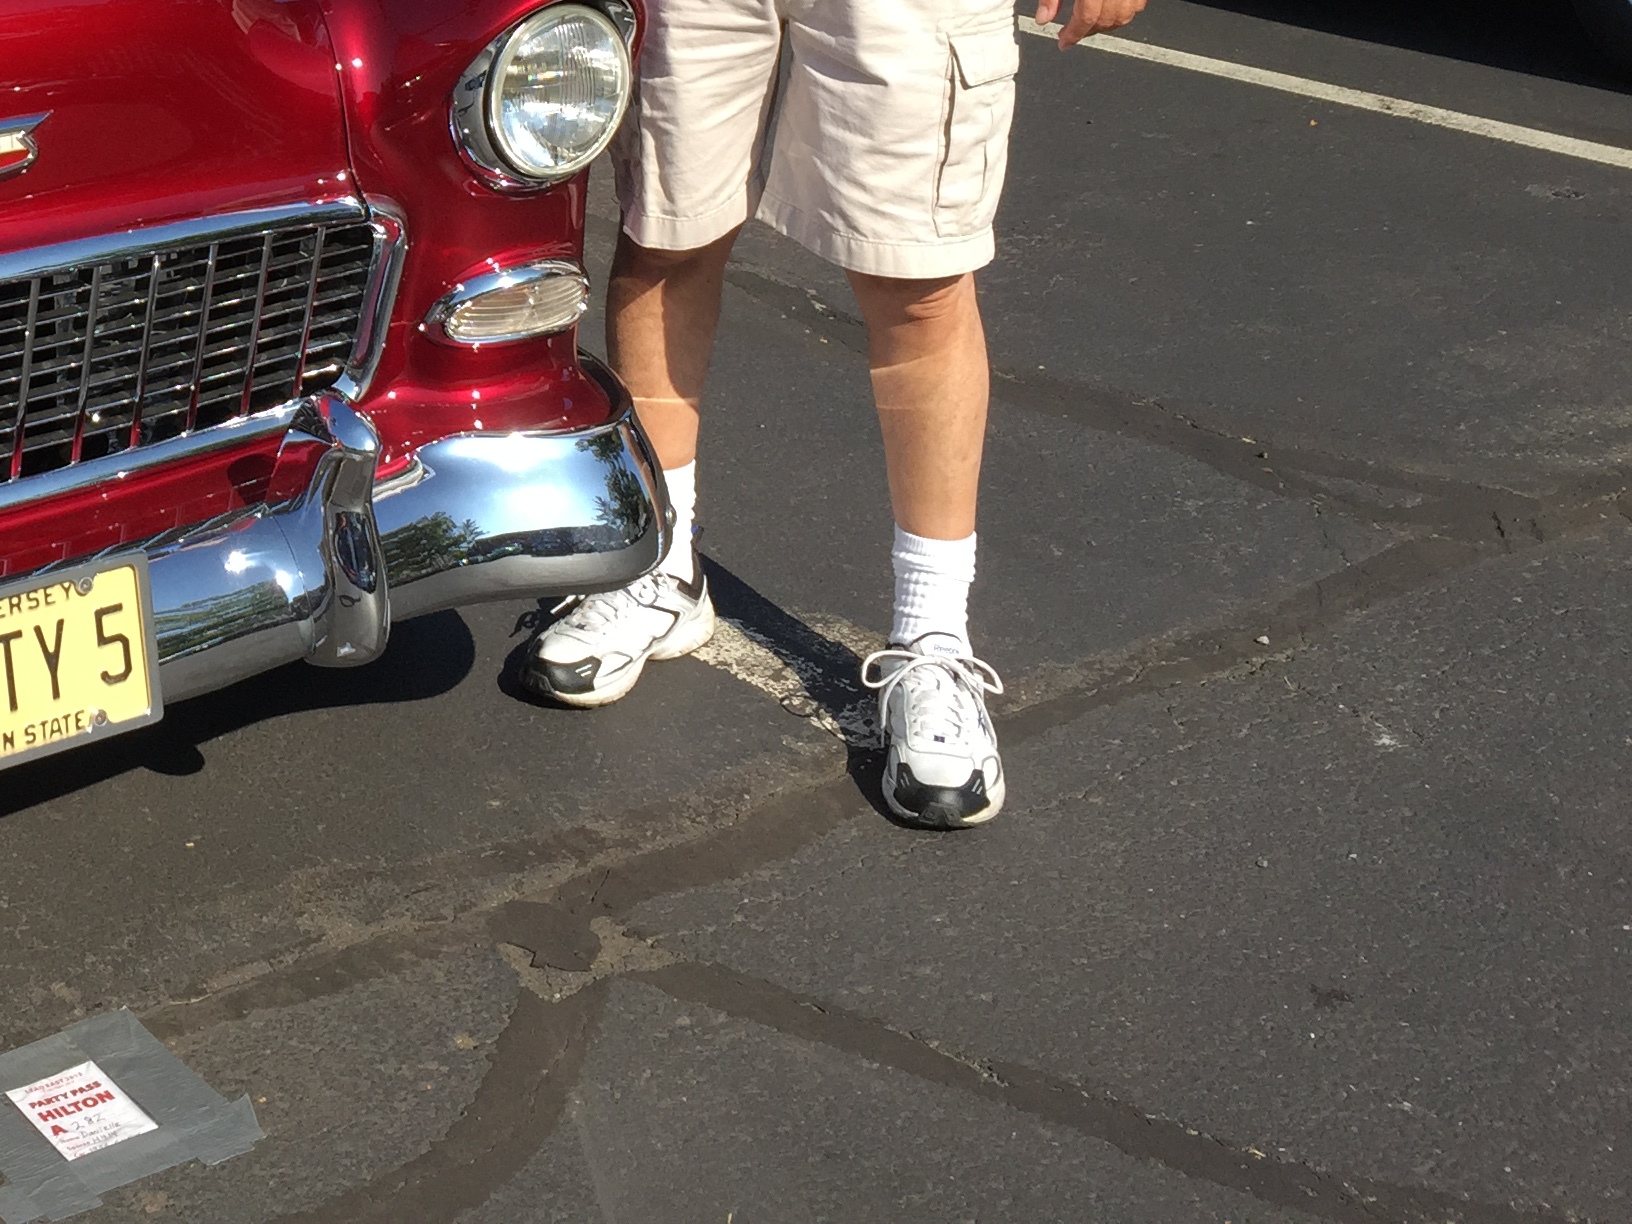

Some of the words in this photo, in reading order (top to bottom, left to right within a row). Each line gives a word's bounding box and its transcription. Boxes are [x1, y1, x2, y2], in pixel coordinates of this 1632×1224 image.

[94, 603, 133, 686] 5
[24, 710, 85, 745] STATE
[28, 1092, 68, 1109] PARTY
[70, 1081, 102, 1097] PASS
[37, 1090, 116, 1122] HILTON
[50, 1124, 68, 1136] A
